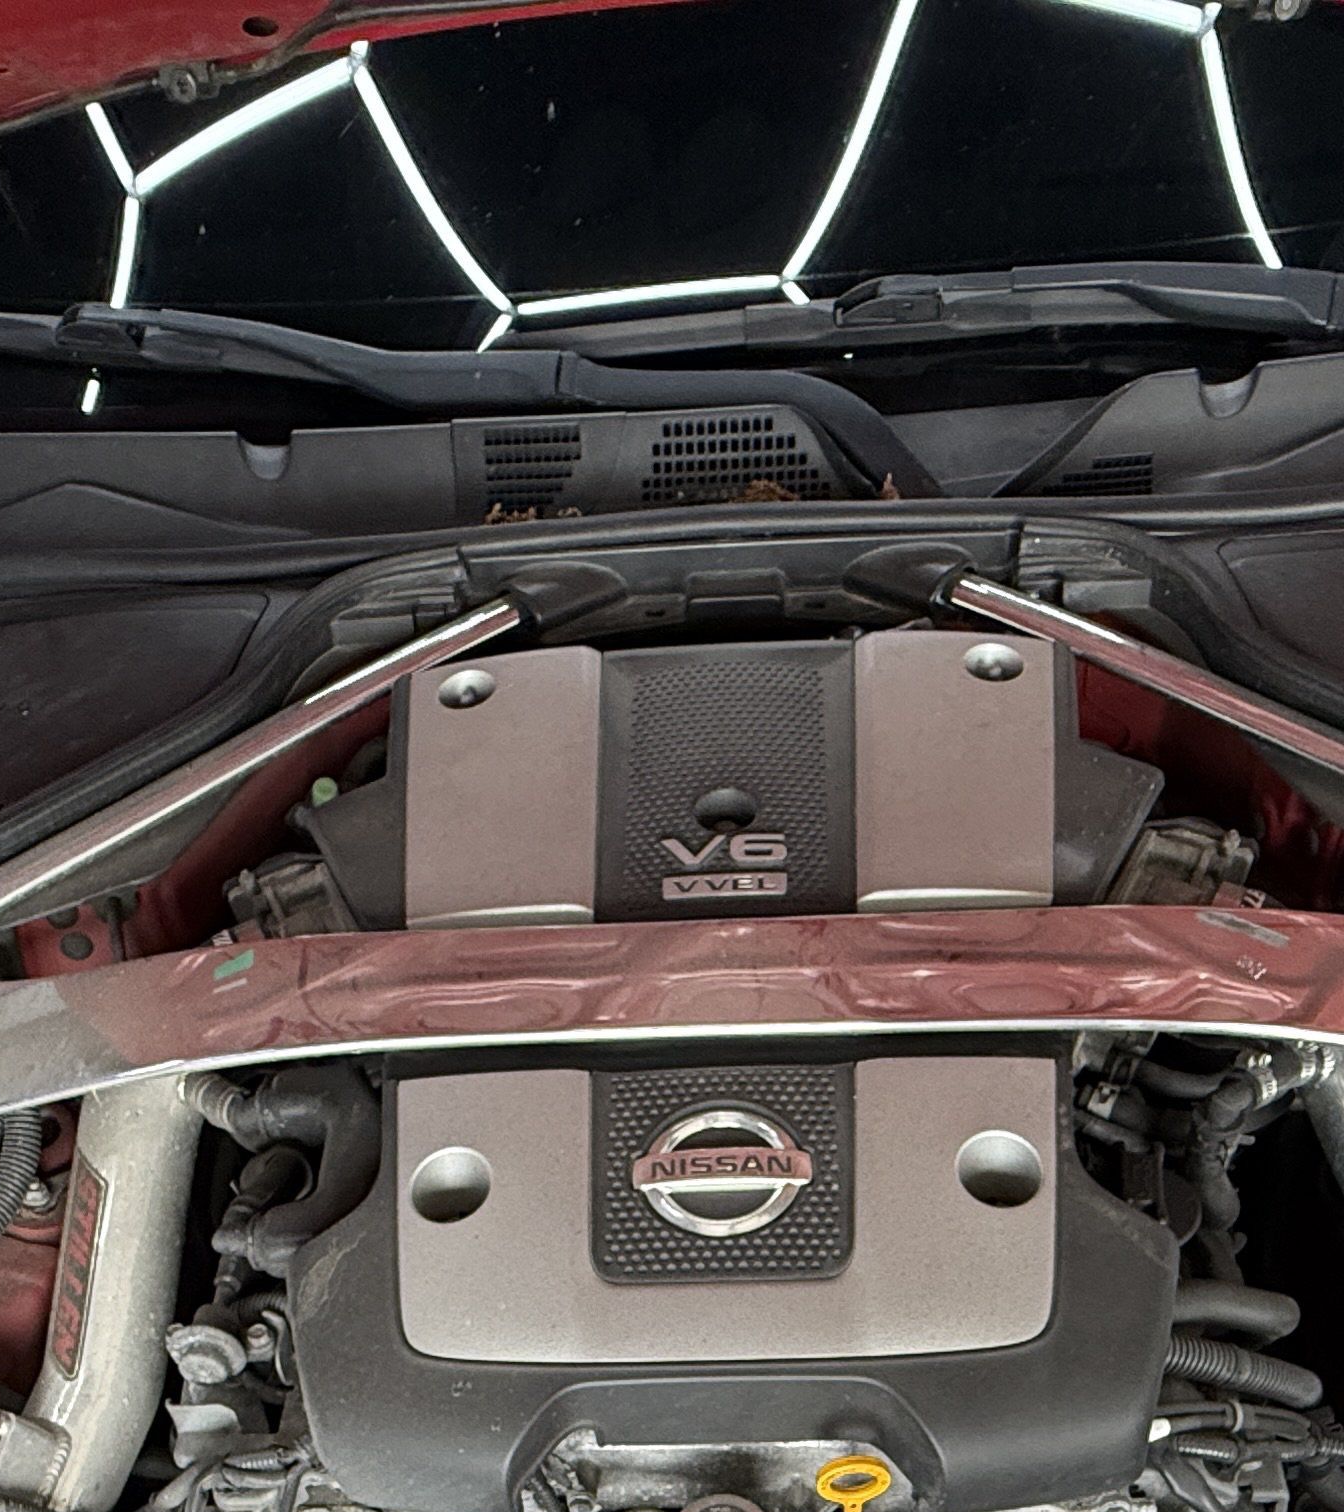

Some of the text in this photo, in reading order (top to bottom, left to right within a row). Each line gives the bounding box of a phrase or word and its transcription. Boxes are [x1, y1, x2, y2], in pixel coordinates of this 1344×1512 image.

[660, 832, 788, 866] V6
[672, 875, 778, 893] VVEL
[650, 1155, 793, 1179] NISSAN
[52, 1173, 99, 1370] STILLEN
